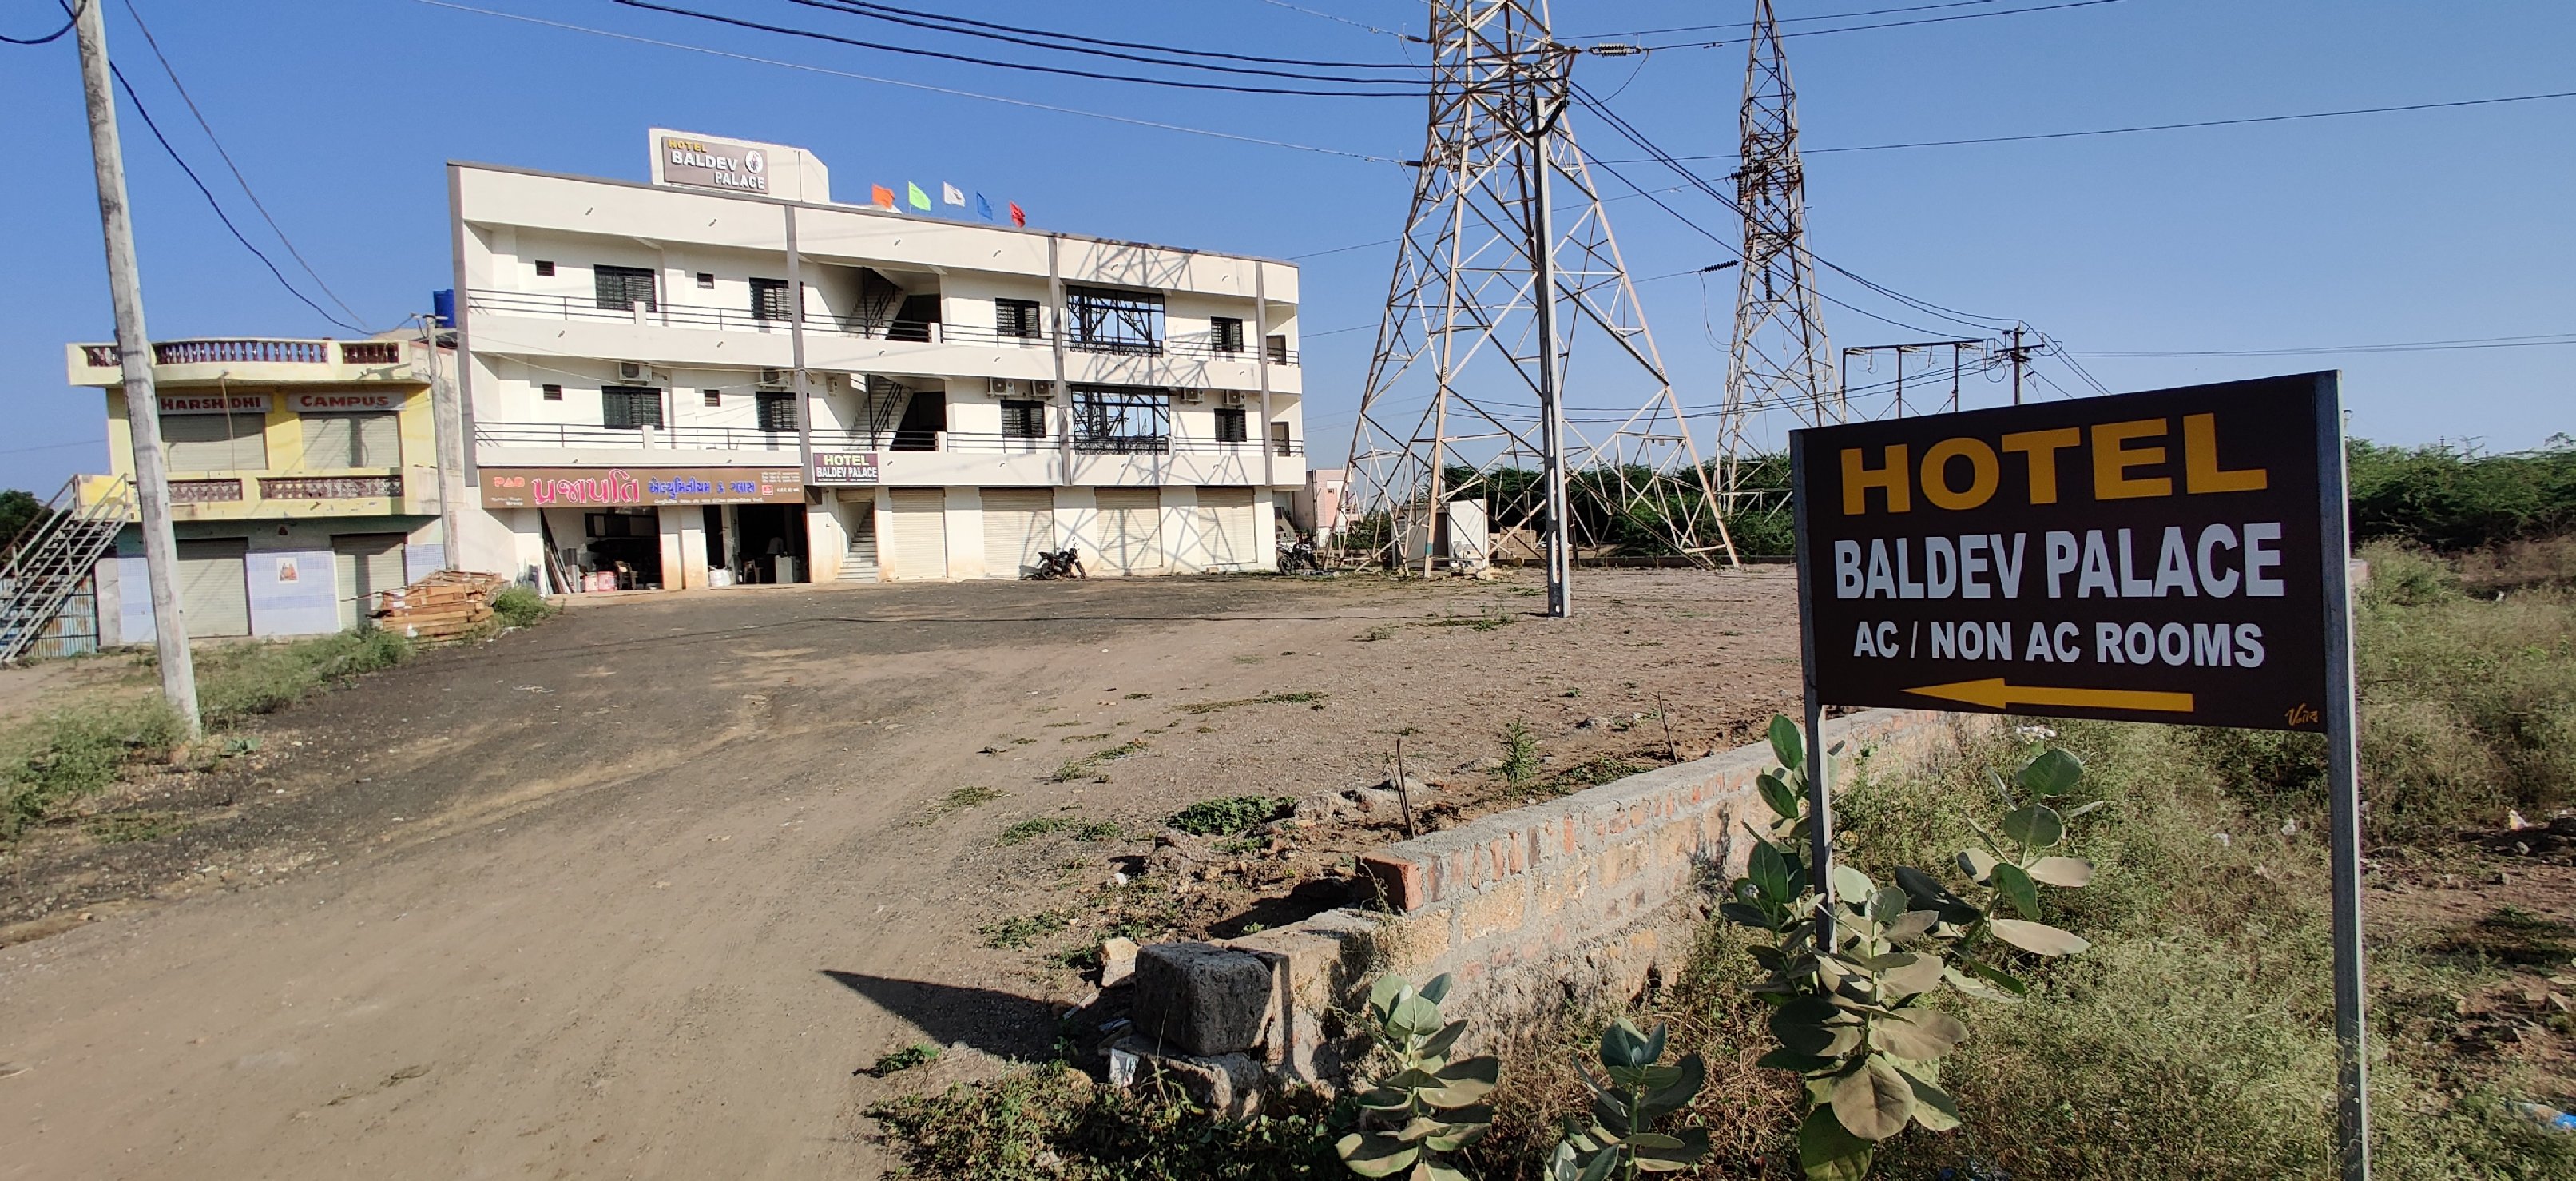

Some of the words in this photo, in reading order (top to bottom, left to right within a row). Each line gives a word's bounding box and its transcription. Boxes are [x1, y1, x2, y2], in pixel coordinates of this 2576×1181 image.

[668, 140, 707, 153] HOTEL
[672, 151, 737, 171] BALDEV
[715, 171, 764, 189] PALACE
[300, 395, 389, 408] CAMPUS
[823, 454, 870, 466] HOTEL
[1840, 412, 2268, 515] HOTEL
[816, 467, 847, 478] BALDEV
[848, 467, 877, 478] PALACE
[531, 469, 639, 504] પ્રજાપતિ
[1834, 532, 2026, 599] BALDEV
[2045, 522, 2284, 598] PALACE
[1853, 621, 1899, 658] AC
[1930, 621, 2013, 661] NON
[2025, 621, 2081, 662] AC
[2095, 621, 2265, 668] ROOMS
